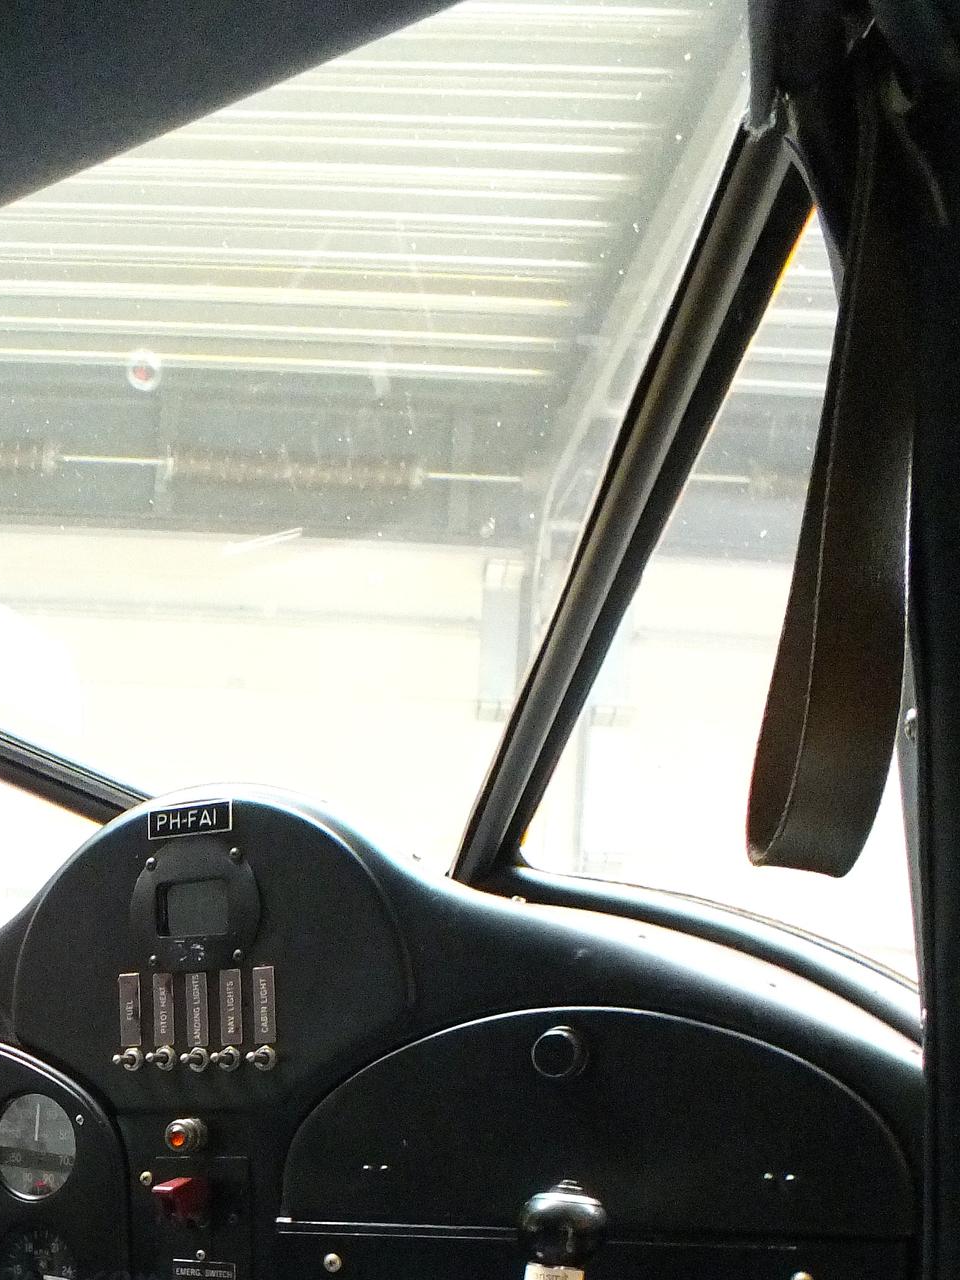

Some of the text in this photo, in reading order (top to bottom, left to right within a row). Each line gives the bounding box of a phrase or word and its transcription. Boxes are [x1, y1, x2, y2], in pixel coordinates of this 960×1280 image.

[156, 808, 217, 831] PH-FAI
[126, 1000, 134, 1020] FUEL
[191, 974, 201, 1045] LANDING LIGHTS
[226, 981, 235, 1034] NAV LIGHTS
[259, 978, 269, 1033] CABIN LIGHT
[175, 1266, 233, 1280] EMERG. SWITCH
